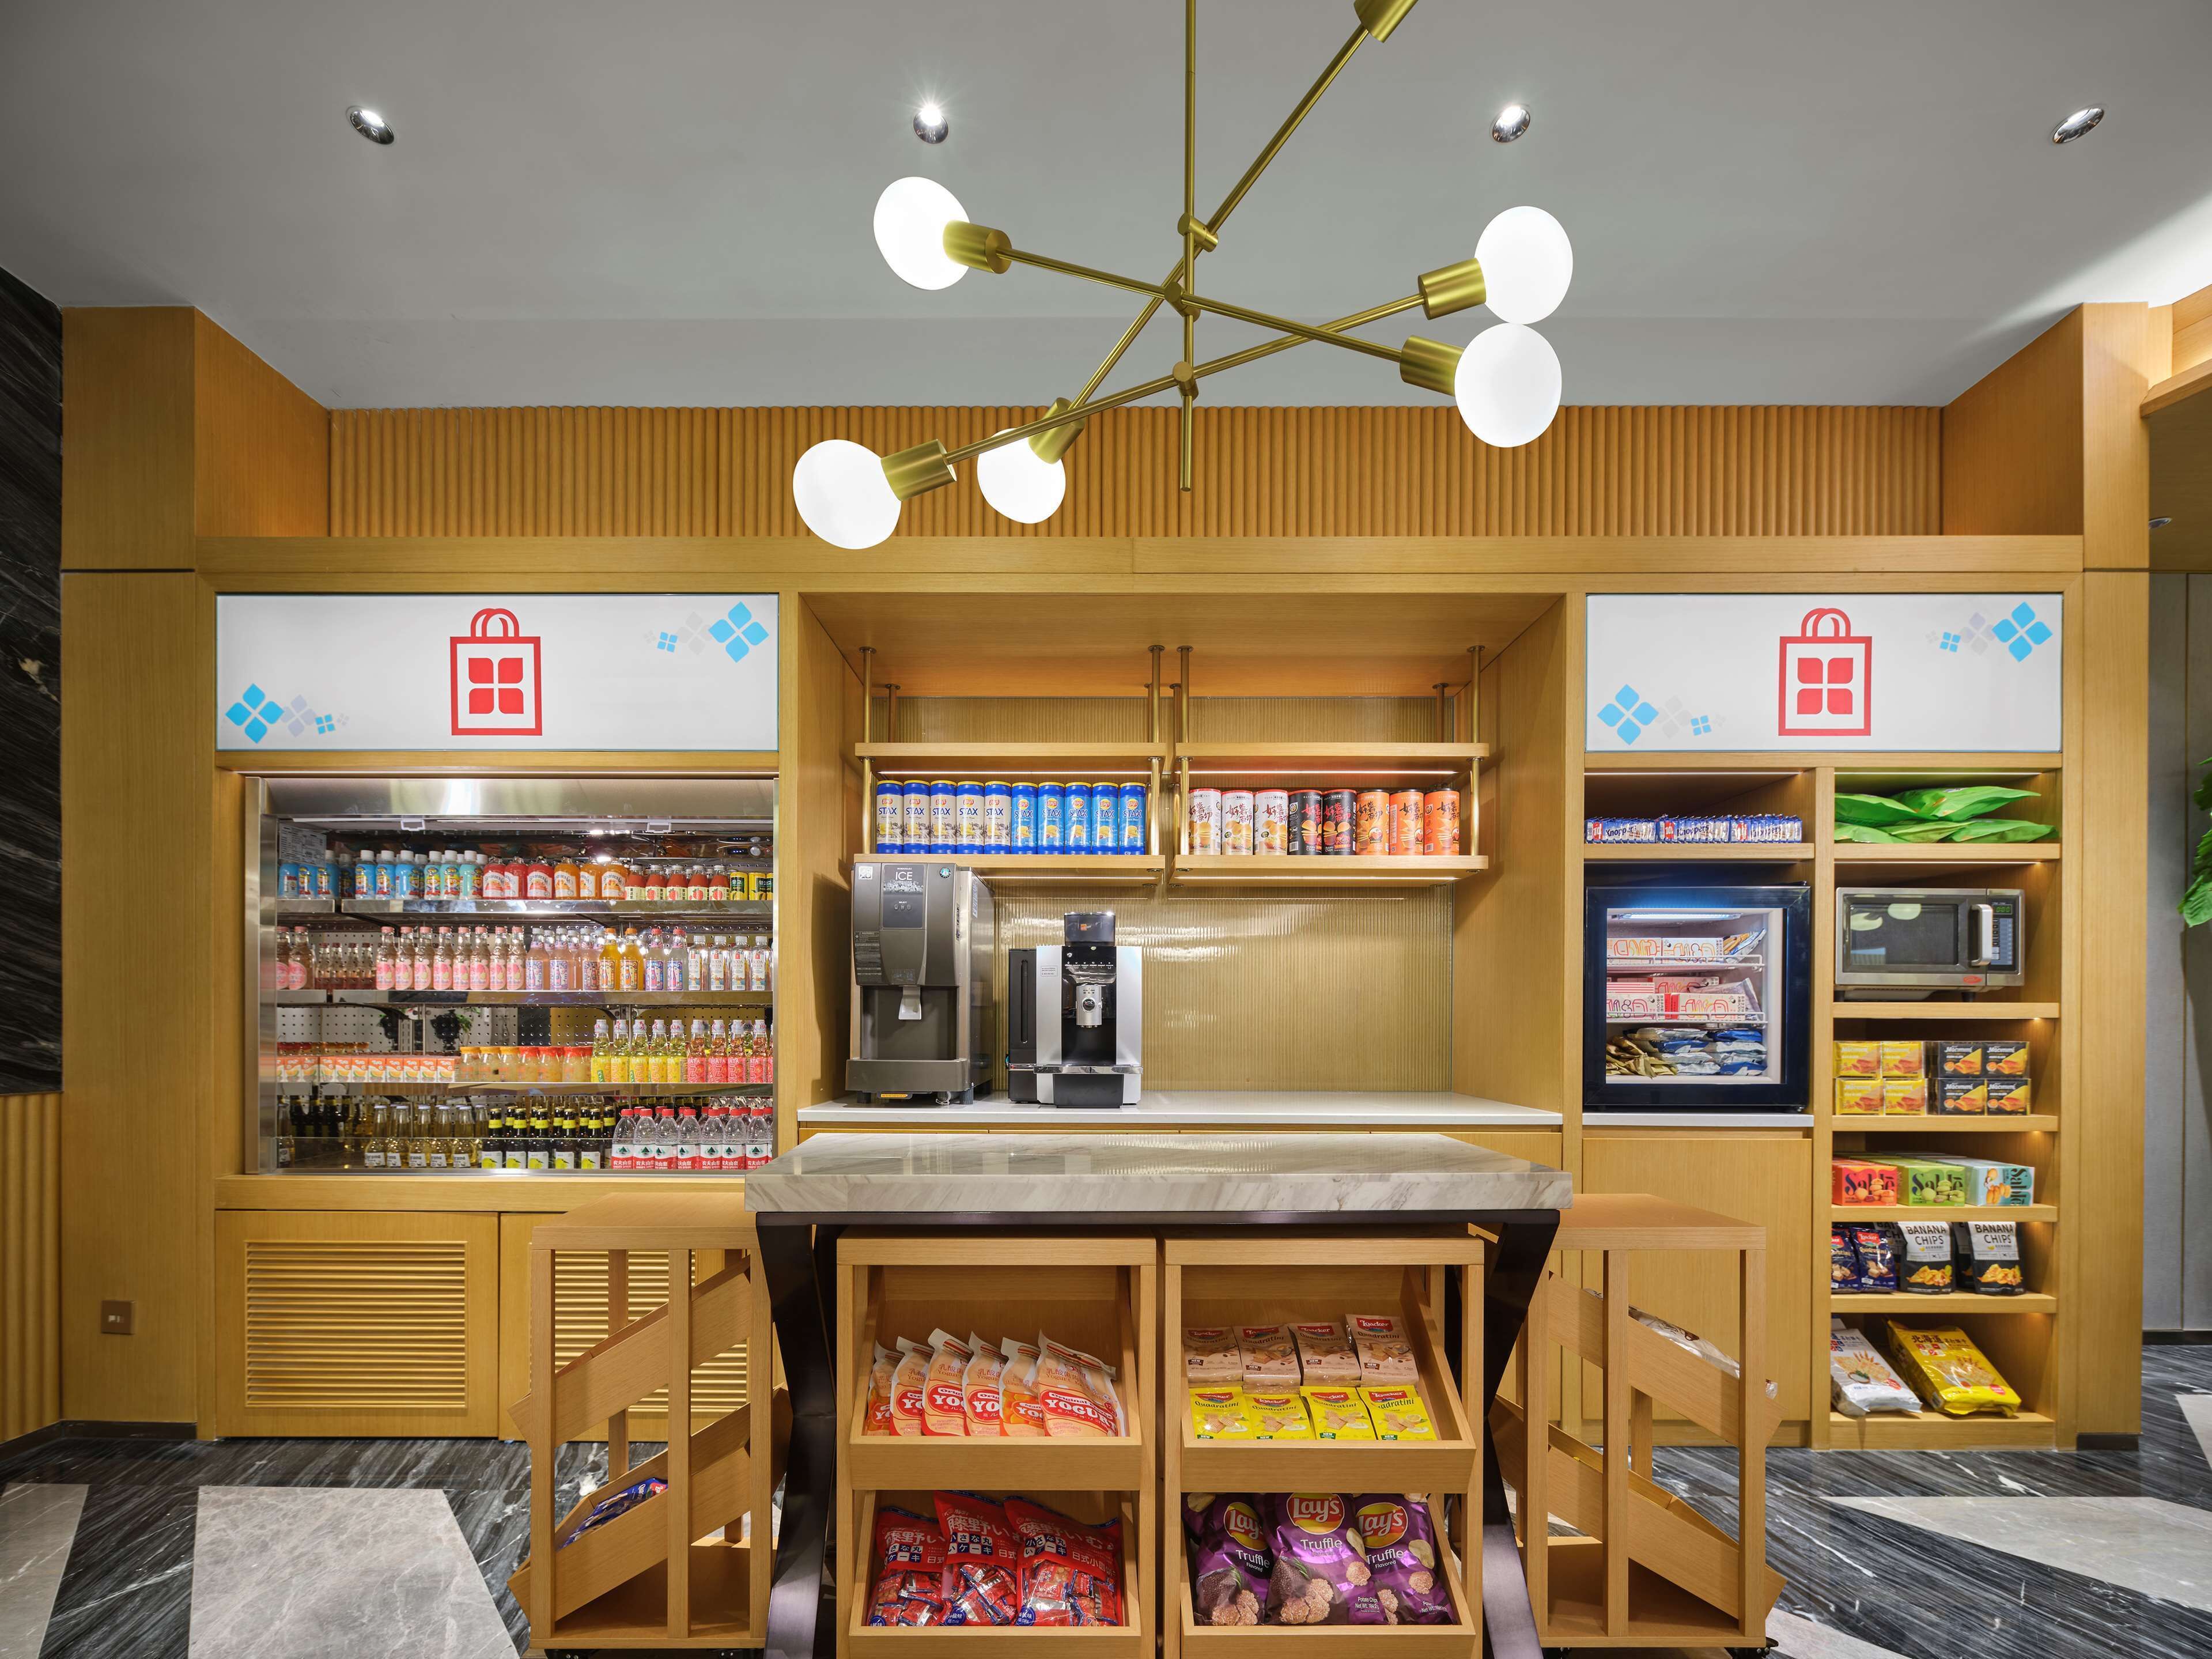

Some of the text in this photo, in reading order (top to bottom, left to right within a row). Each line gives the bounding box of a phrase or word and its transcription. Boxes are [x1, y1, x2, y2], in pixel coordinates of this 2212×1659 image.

[879, 807, 897, 815] STAX
[906, 807, 924, 815] STAX
[932, 808, 951, 816] STAX
[959, 808, 978, 816] STAX
[986, 808, 1004, 816] STAX
[1014, 809, 1033, 818] STAX
[1042, 809, 1061, 818] STAX
[1069, 809, 1088, 818] STAX
[1096, 810, 1115, 818] STAX
[1124, 809, 1143, 818] STAX
[895, 872, 913, 880] ICE
[1906, 1225, 1946, 1234] BANANA
[1975, 1223, 2014, 1233] BANANA
[1915, 1235, 1944, 1245] CHIPS
[1984, 1234, 2012, 1244] CHIPS
[1360, 1319, 1389, 1328] Loacker
[1300, 1332, 1341, 1341] Quadratini
[1358, 1331, 1400, 1339] Quadratini
[1912, 1335, 1945, 1344] 北海道
[973, 1401, 1000, 1412] YO
[1195, 1400, 1239, 1408] Quadratini
[1313, 1399, 1357, 1408] Quadratini
[1380, 1399, 1415, 1409] uadratini
[1045, 1399, 1117, 1432] YOGURT
[1294, 1498, 1340, 1522] Lay's
[1359, 1510, 1404, 1537] Lay's
[1026, 1535, 1066, 1547] 小さな丸
[1300, 1537, 1343, 1550] Truffle
[889, 1544, 923, 1553] さな丸
[1235, 1550, 1270, 1568] Truffle
[1366, 1548, 1404, 1565] Truffle
[1246, 1562, 1263, 1572] Flavored
[1375, 1559, 1397, 1569] Flavored
